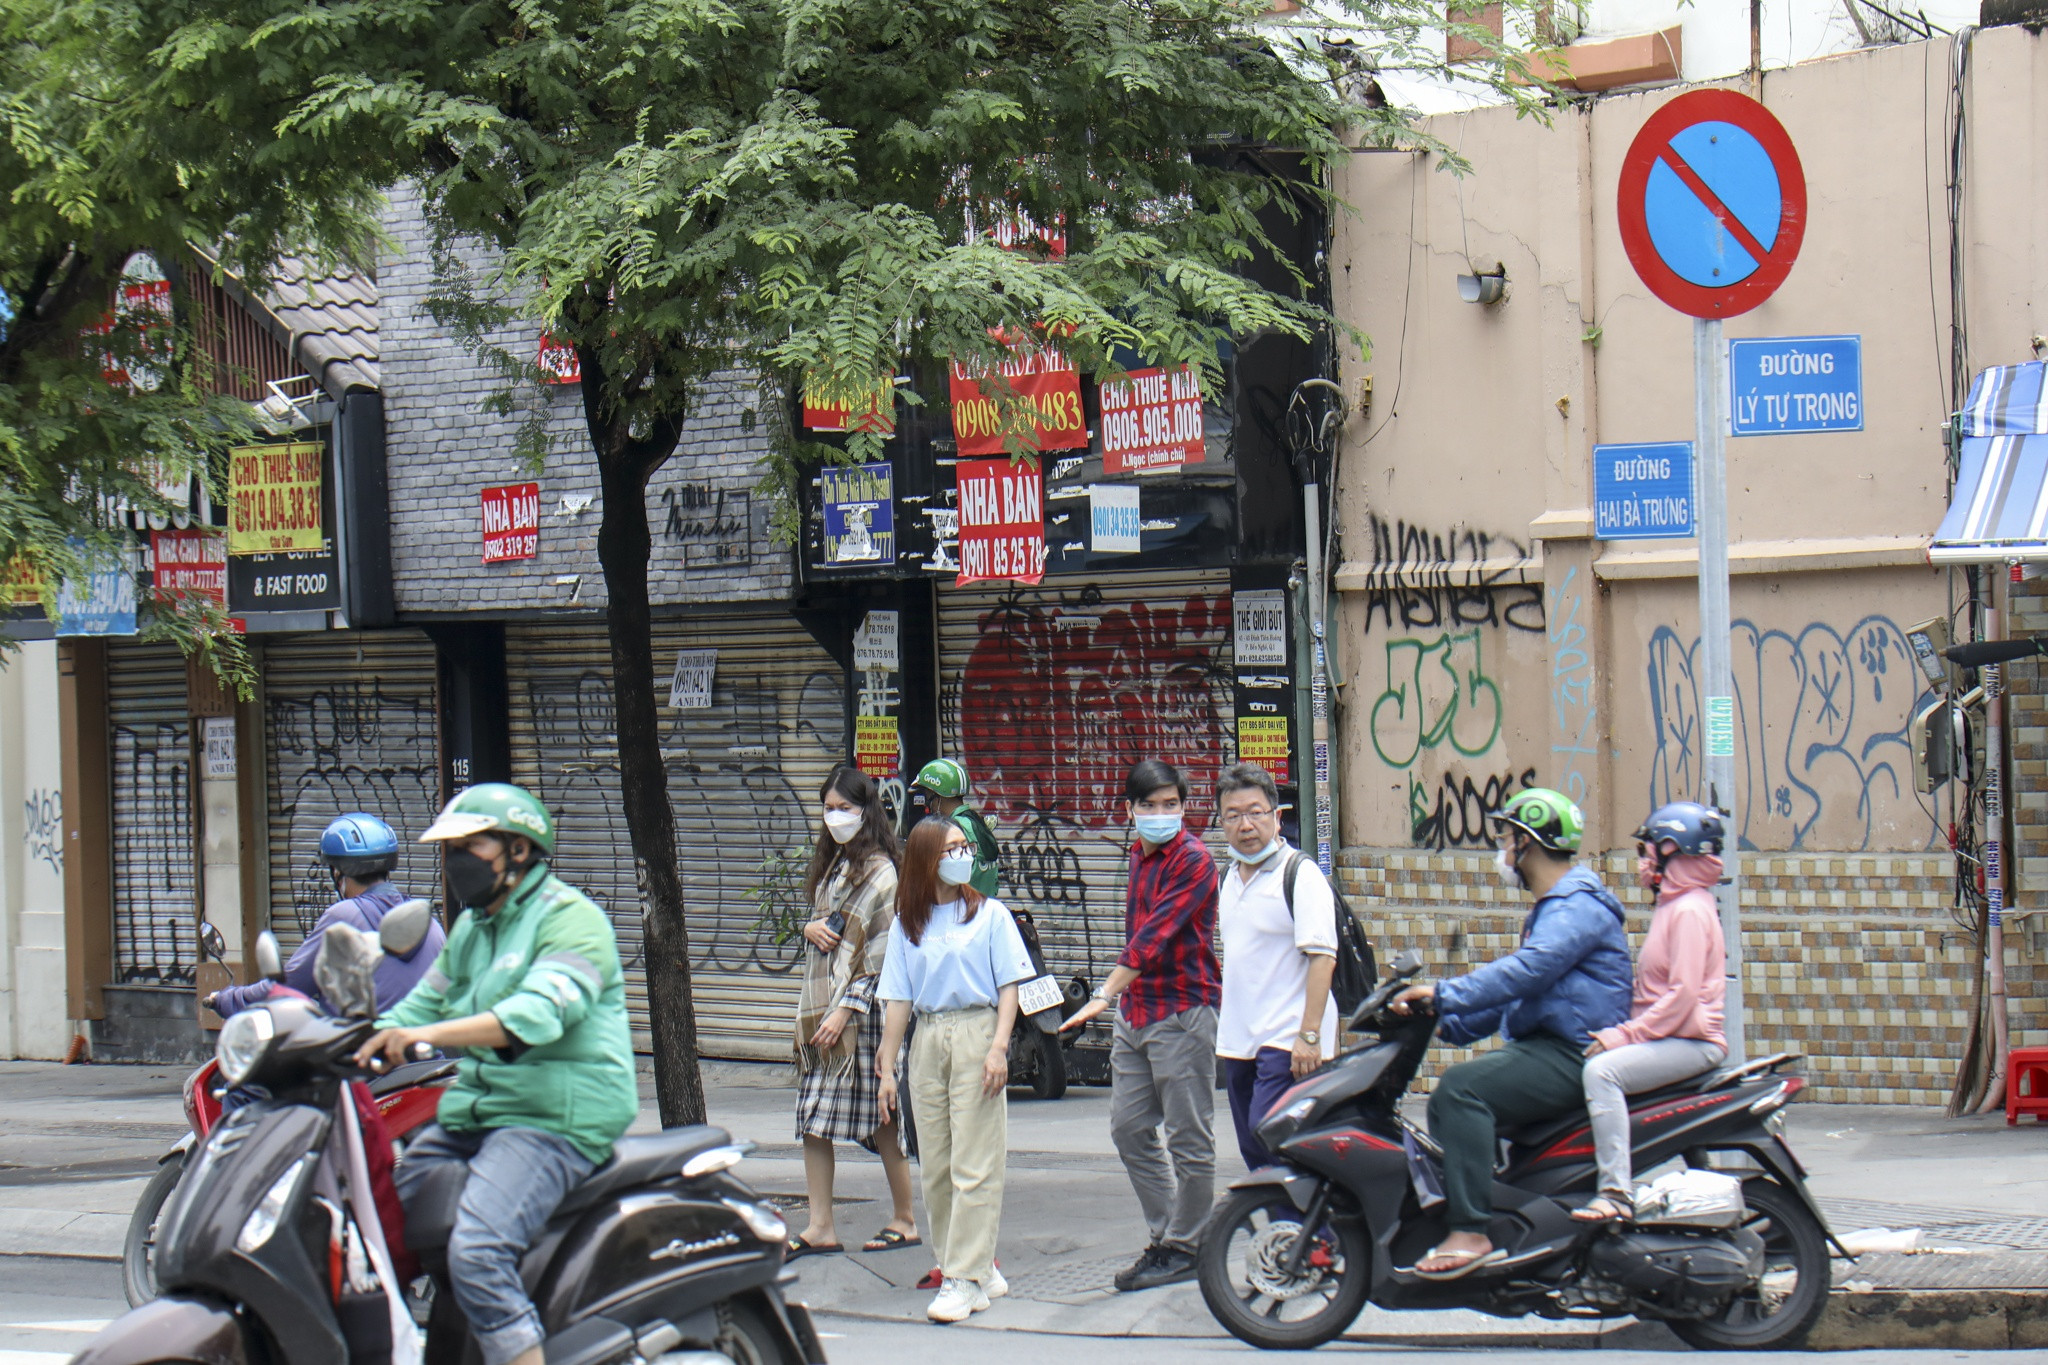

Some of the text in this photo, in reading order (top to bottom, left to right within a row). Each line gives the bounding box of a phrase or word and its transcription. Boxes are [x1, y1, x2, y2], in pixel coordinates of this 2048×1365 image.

[1759, 349, 1834, 376] ĐƯỜNG
[956, 397, 1003, 438] 0908
[1041, 390, 1082, 432] 083
[1738, 387, 1858, 428] LÝ TỰ TRỌNG
[1103, 401, 1203, 452] 0906.905.006
[1147, 448, 1169, 466] (chính
[1170, 445, 1186, 463] chủ)
[1614, 455, 1671, 481] ĐƯỜNG
[235, 455, 259, 486] CHO
[483, 487, 537, 533] NHÀ BÁN
[961, 465, 1040, 526] NHÀ BÁN
[1599, 492, 1688, 528] HAI BÀ TRƯNG
[179, 538, 198, 563] CHO
[484, 534, 537, 559] 0902 319 257
[962, 536, 1043, 576] 0901 85 25 78
[254, 574, 328, 596] & FAST FOOD
[1237, 602, 1283, 631] THẾ GIỚI BÚT
[675, 696, 694, 707] ANH
[452, 759, 469, 776] 115
[924, 774, 941, 787] Grab
[507, 806, 547, 835] Grab
